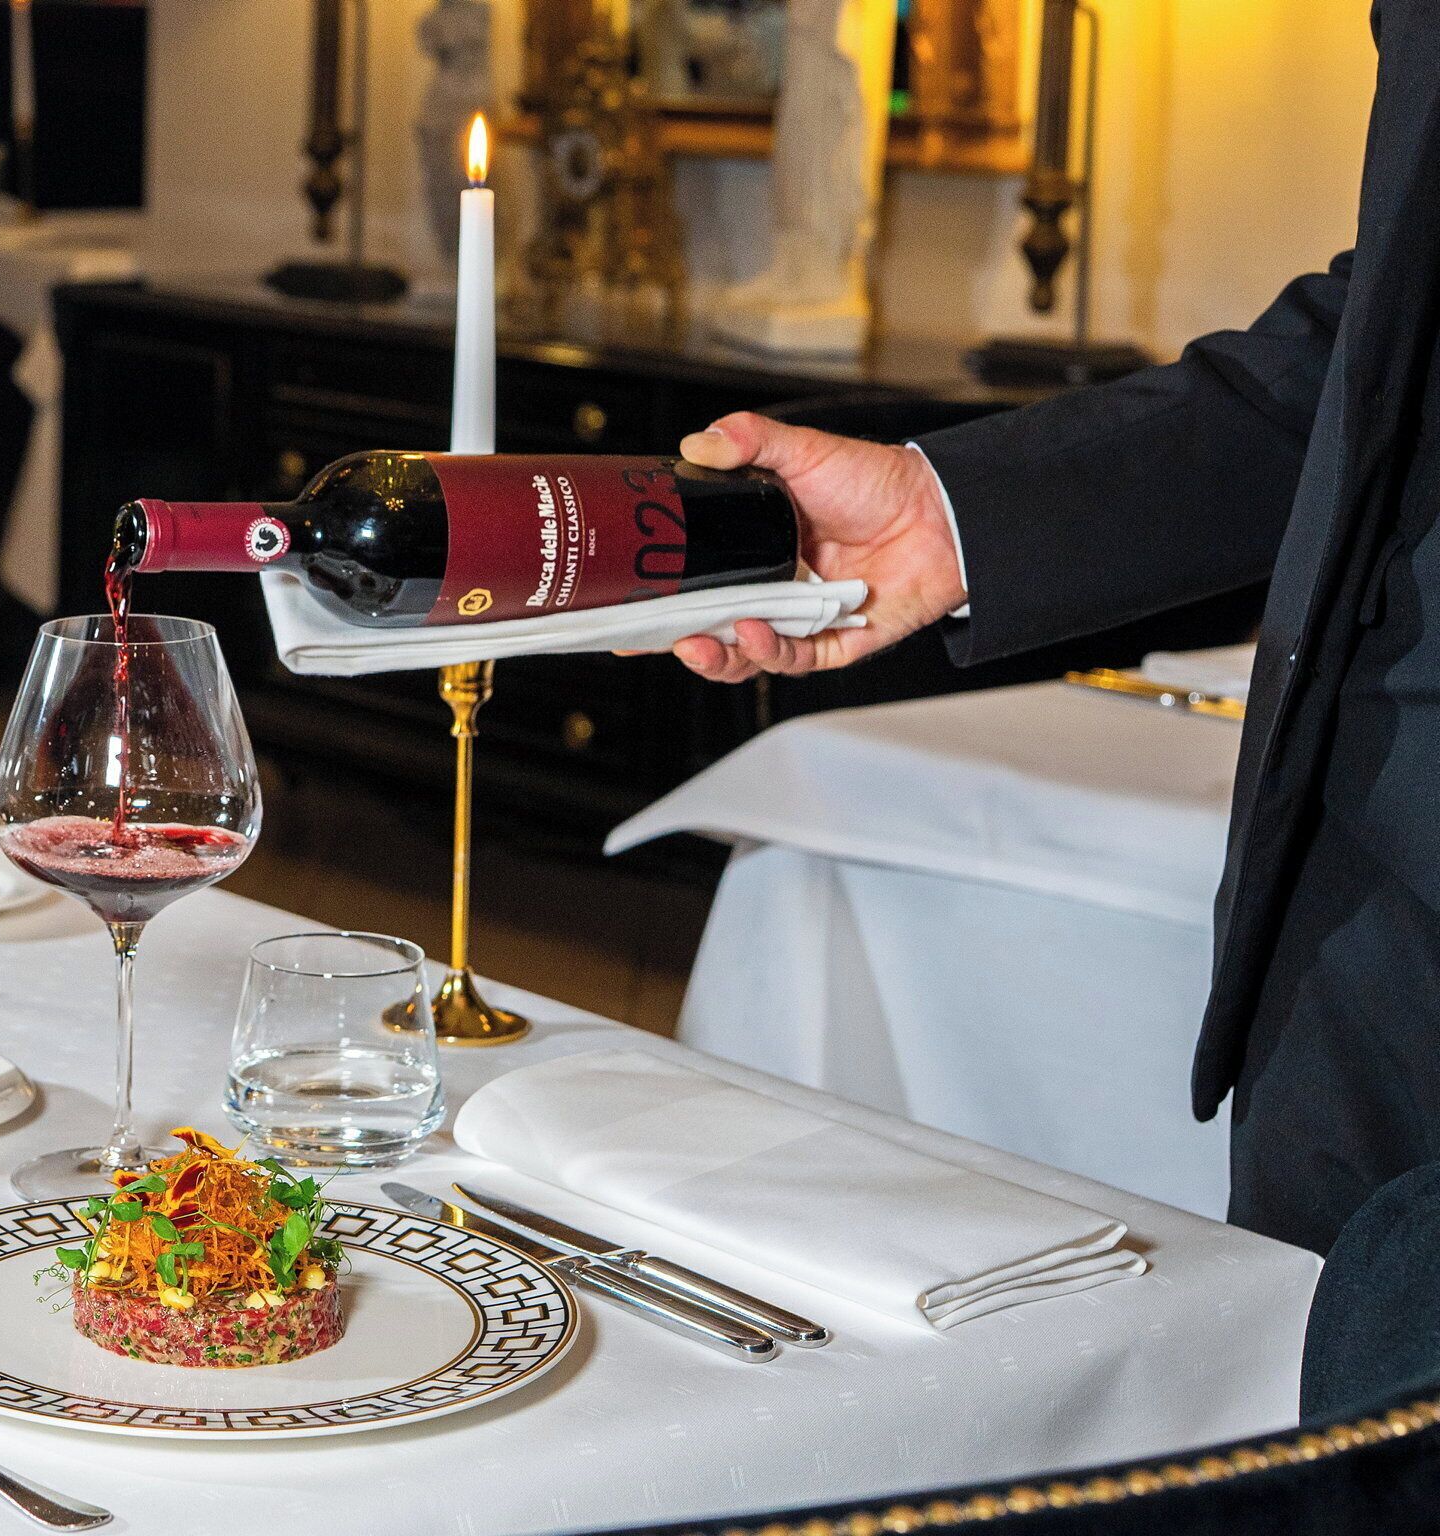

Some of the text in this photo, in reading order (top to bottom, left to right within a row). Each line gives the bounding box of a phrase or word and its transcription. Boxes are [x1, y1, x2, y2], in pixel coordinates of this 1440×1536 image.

[540, 519, 558, 561] delle
[555, 476, 579, 606] CHIANTI CLASSICO
[525, 561, 556, 606] Rocca
